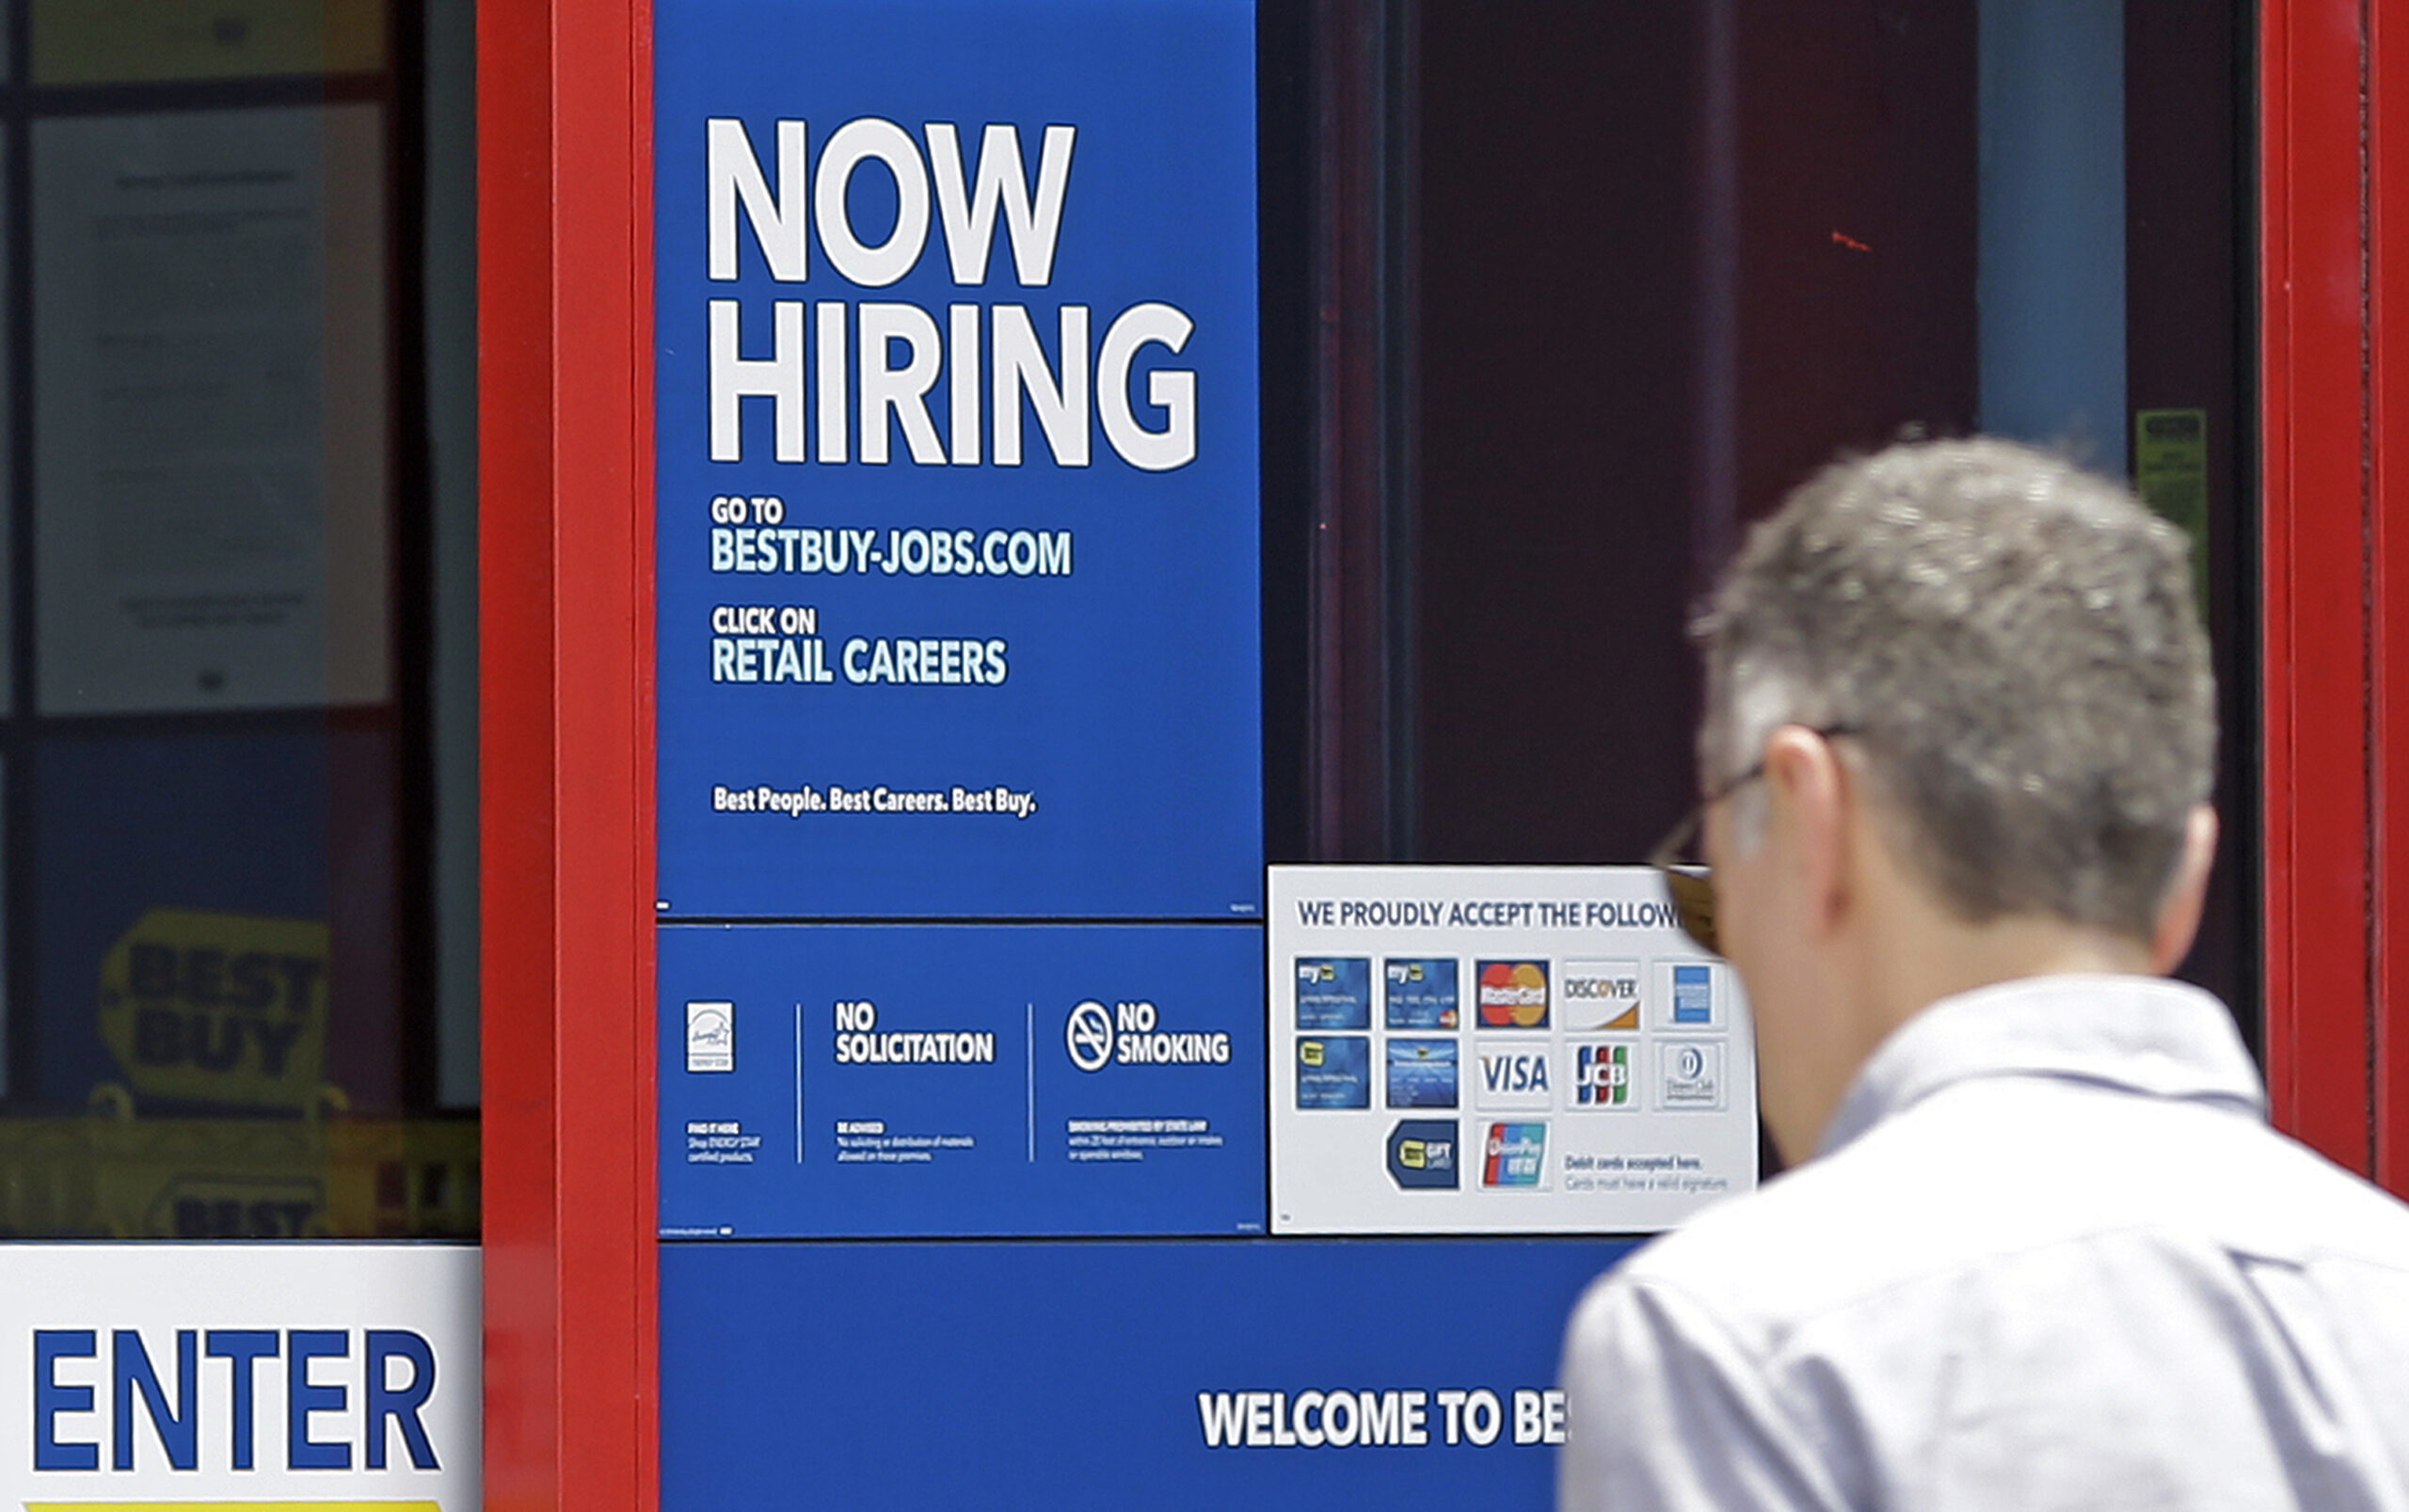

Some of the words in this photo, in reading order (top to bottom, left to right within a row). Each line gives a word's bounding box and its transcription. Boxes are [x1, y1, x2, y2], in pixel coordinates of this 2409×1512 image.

[707, 118, 1077, 287] NOW
[709, 299, 1197, 471] HIRING
[711, 496, 746, 524] GO
[752, 497, 783, 524] TO
[711, 529, 1071, 576] BESTBUY-JOBS.COM
[712, 608, 774, 634] CLICK
[780, 608, 816, 634] ON
[712, 639, 834, 683] RETAIL
[842, 638, 1007, 685] CAREERS
[714, 788, 754, 811] Best
[758, 786, 826, 818] People.
[829, 788, 870, 811] Best
[873, 788, 949, 811] Careers.
[952, 788, 993, 812] Best
[996, 788, 1036, 819] Buy.
[1298, 900, 1334, 927] WE
[1340, 900, 1444, 927] PROUDLY
[1447, 900, 1534, 927] ACCEPT
[1540, 901, 1587, 927] THE
[1587, 901, 1683, 928] FOLLOW
[129, 944, 322, 1013] BEST
[1565, 979, 1636, 998] DISCOVER
[836, 1002, 875, 1031] NO
[1117, 1003, 1157, 1031] NO
[134, 1008, 305, 1077] BUY
[836, 1034, 994, 1062] SOLICITATION
[1117, 1034, 1231, 1063] SMOKING
[1480, 1056, 1548, 1091] VISA
[1577, 1064, 1627, 1086] JCB
[33, 1329, 441, 1472] ENTER
[1199, 1390, 1428, 1447] WELCOME
[1437, 1390, 1503, 1447] TO
[1514, 1390, 1572, 1444] BE
